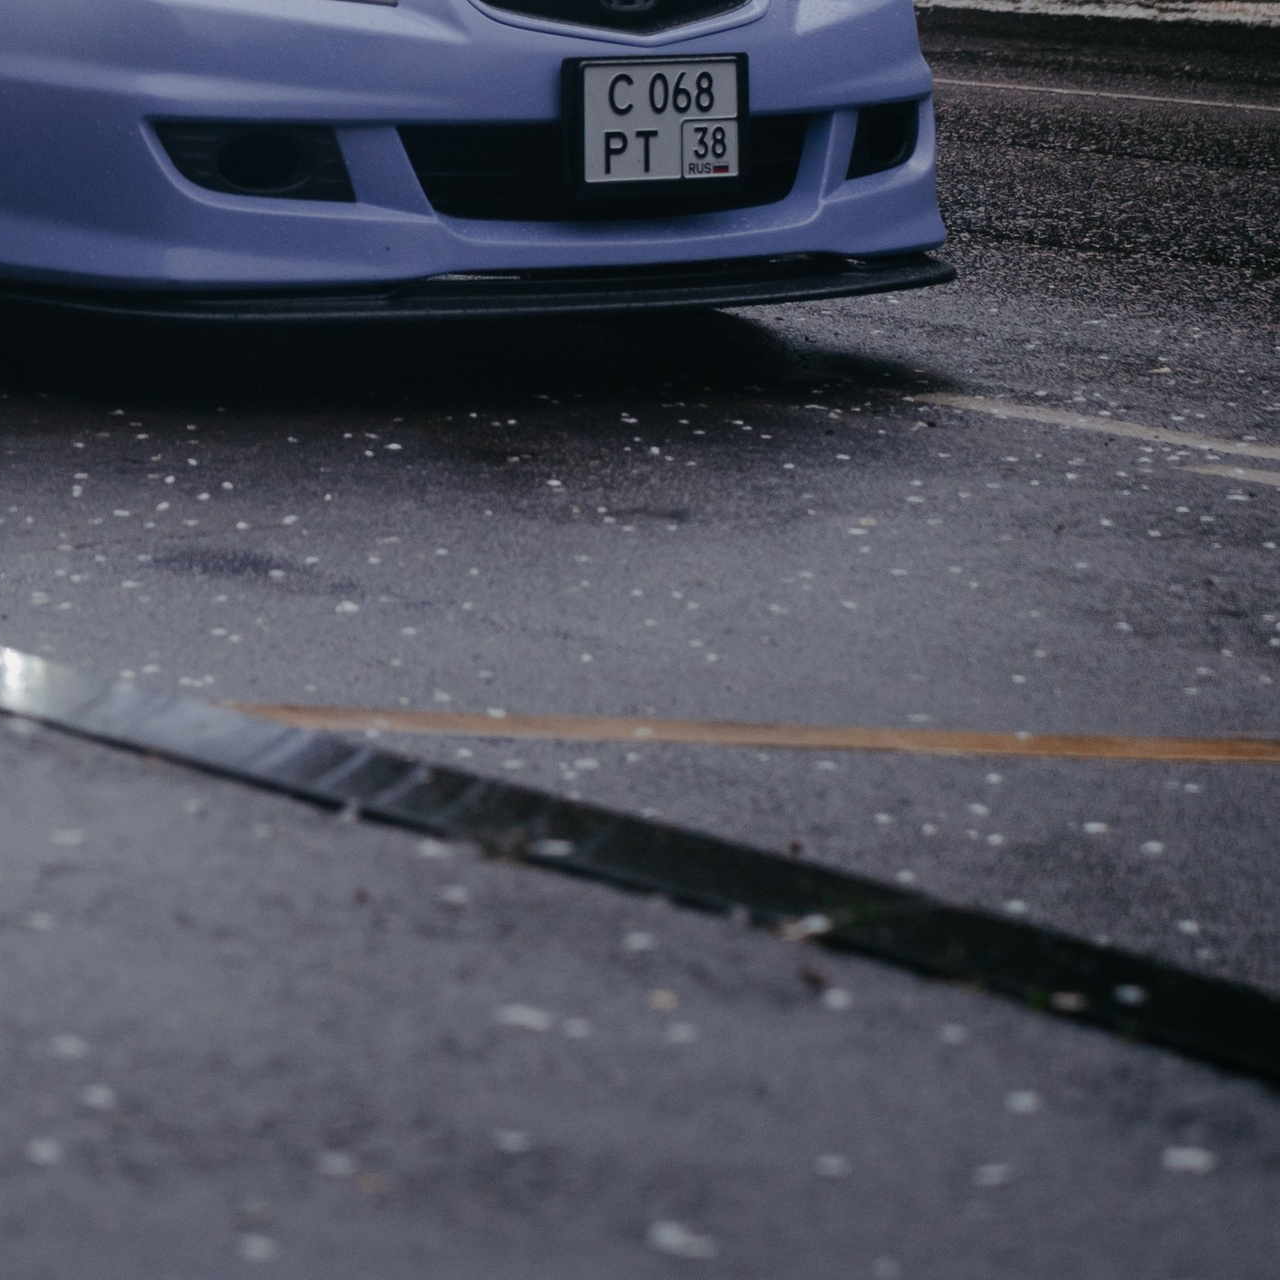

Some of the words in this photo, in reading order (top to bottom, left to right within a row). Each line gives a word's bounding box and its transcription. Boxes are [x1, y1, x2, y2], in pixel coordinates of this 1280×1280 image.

[608, 73, 634, 116] C
[649, 71, 714, 114] 068
[604, 130, 658, 175] PT
[693, 126, 726, 159] 38
[688, 163, 712, 174] RUS
